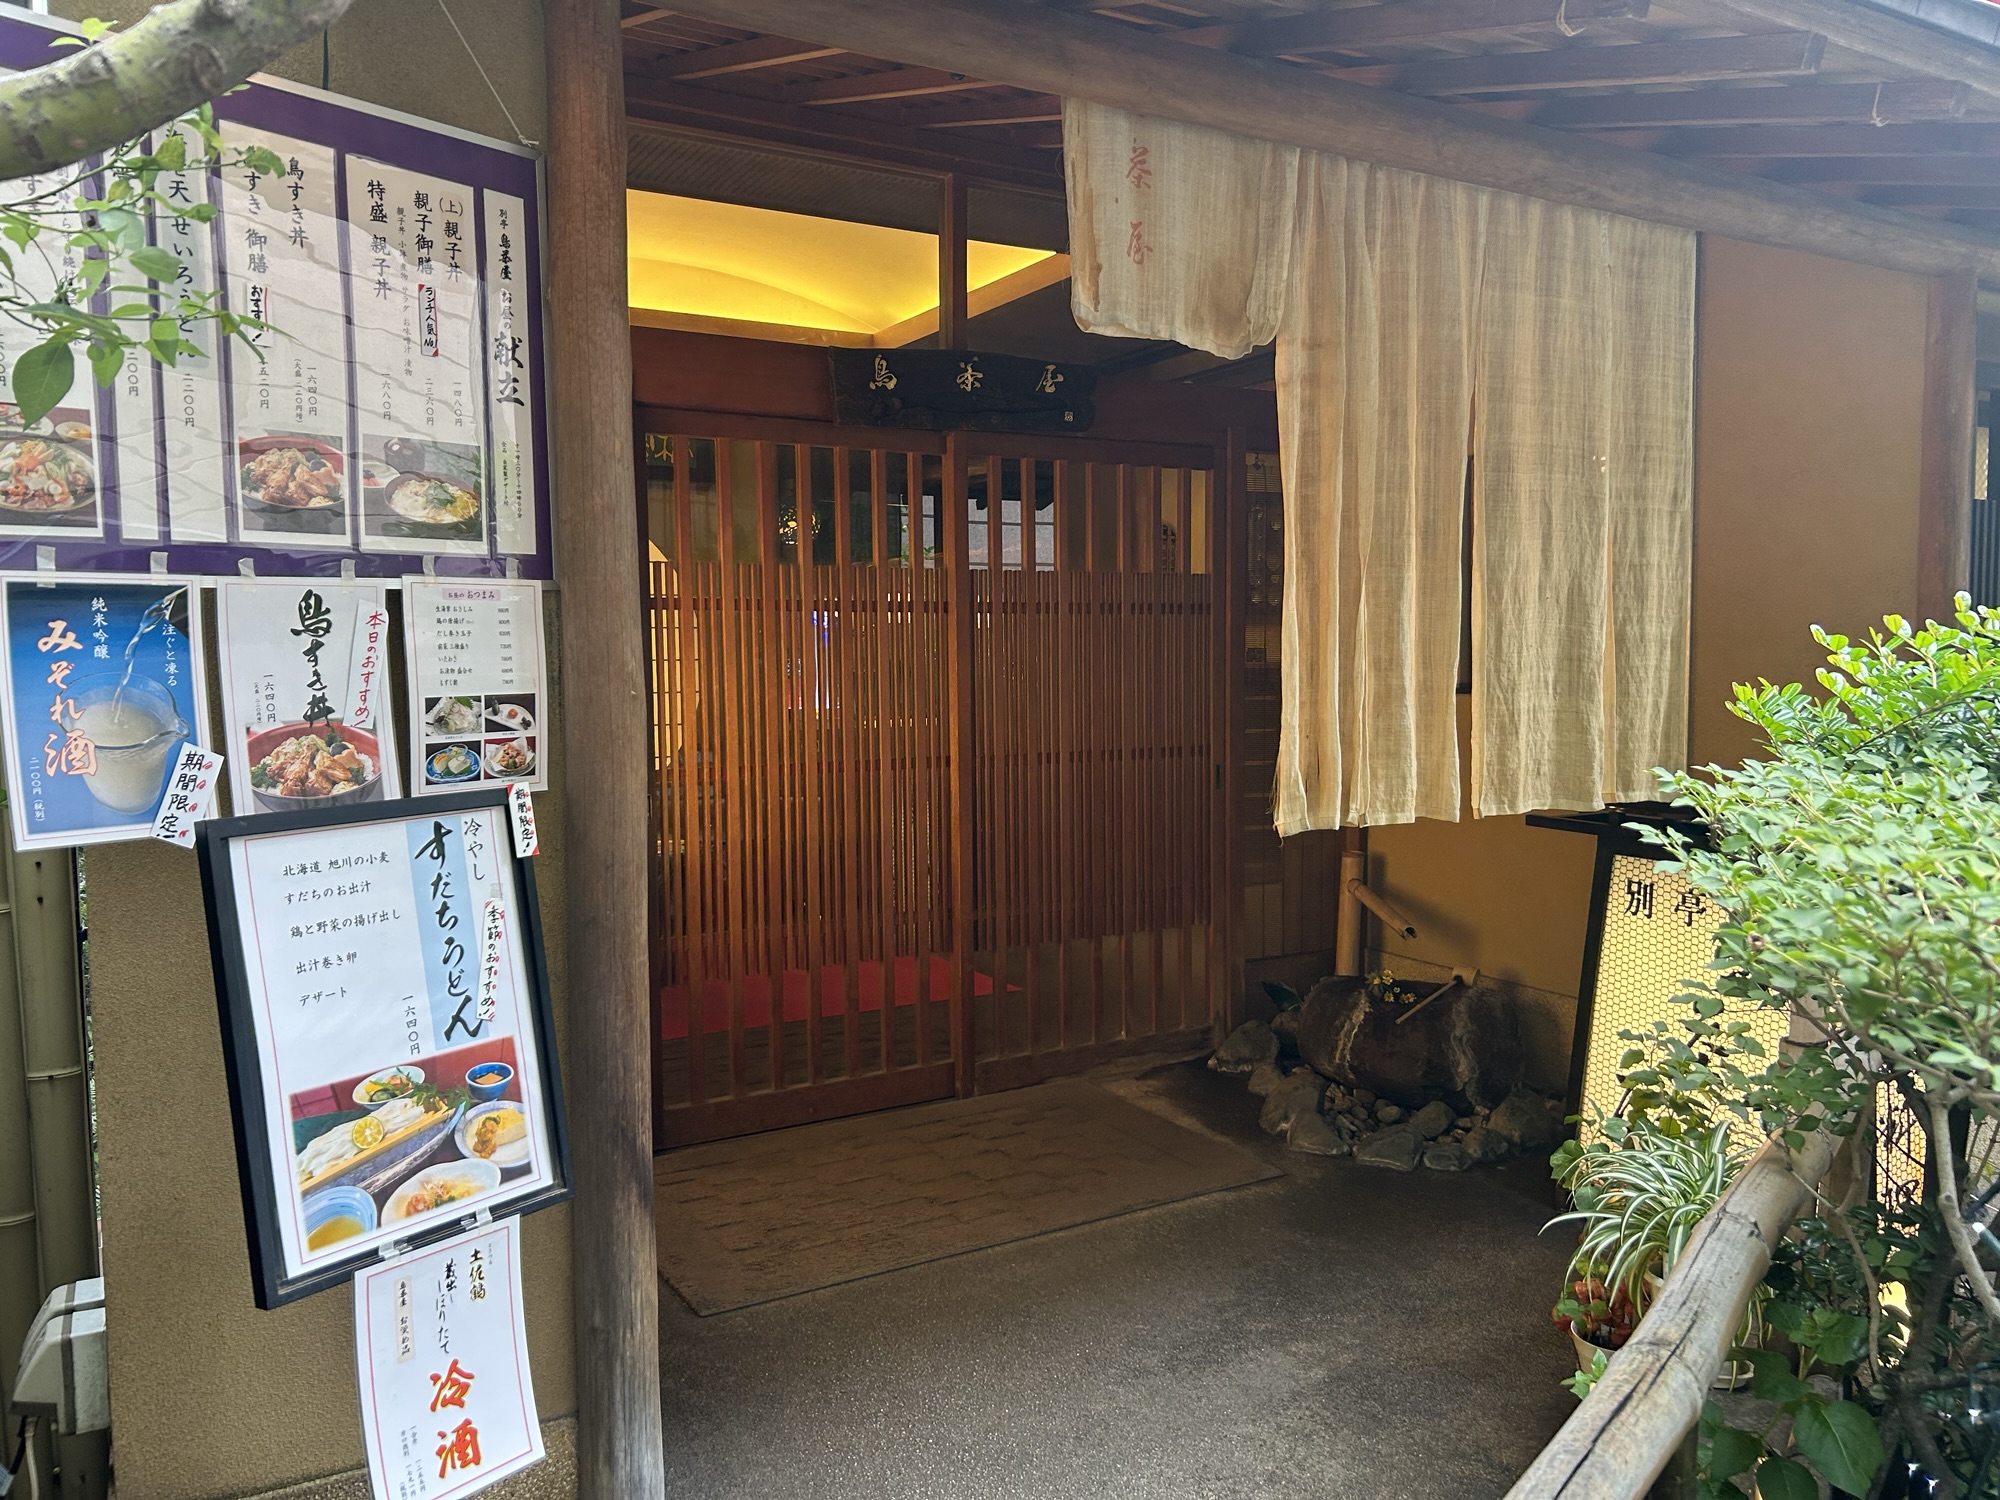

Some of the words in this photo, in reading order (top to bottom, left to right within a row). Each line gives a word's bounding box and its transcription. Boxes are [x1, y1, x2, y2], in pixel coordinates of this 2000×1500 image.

[287, 157, 309, 250] 鳥すき丼
[368, 178, 388, 225] 特盛
[245, 228, 270, 279] 御膳
[413, 190, 435, 276] 親子御膳
[499, 234, 513, 281] 鳥茶屋
[371, 233, 393, 300] 親子丼
[501, 288, 515, 331] お昼の
[307, 367, 319, 416] 一六四〇円
[494, 331, 524, 407] 献立
[868, 353, 1065, 393] 鳥茶屋
[183, 373, 195, 428] 二二〇〇円
[381, 371, 393, 422] 一六八〇円
[425, 377, 435, 427] 二三六〇円
[453, 381, 465, 428] 一四八〇円
[467, 589, 496, 600] おつまみ
[91, 597, 111, 660] 純米吟醸
[162, 623, 181, 688] 注ぐと凍る
[291, 588, 336, 729] 鳥すき丼
[37, 620, 98, 777] みぞれ酒
[263, 674, 277, 723] 一六四〇円
[283, 860, 323, 877] 北海道
[328, 851, 391, 871] 旭川の小麦
[464, 817, 486, 881] 冷やし
[284, 880, 372, 906] すだちのお出汁
[1624, 878, 1707, 927] 別亭
[290, 908, 401, 939] 鶏と野菜の揚げ出し
[414, 820, 483, 1042] すだちうどん
[296, 951, 358, 975] 出汁巻き卵
[299, 986, 348, 1008] デザート
[402, 995, 421, 1056] 一六四〇円
[429, 1358, 482, 1480] 冷酒
